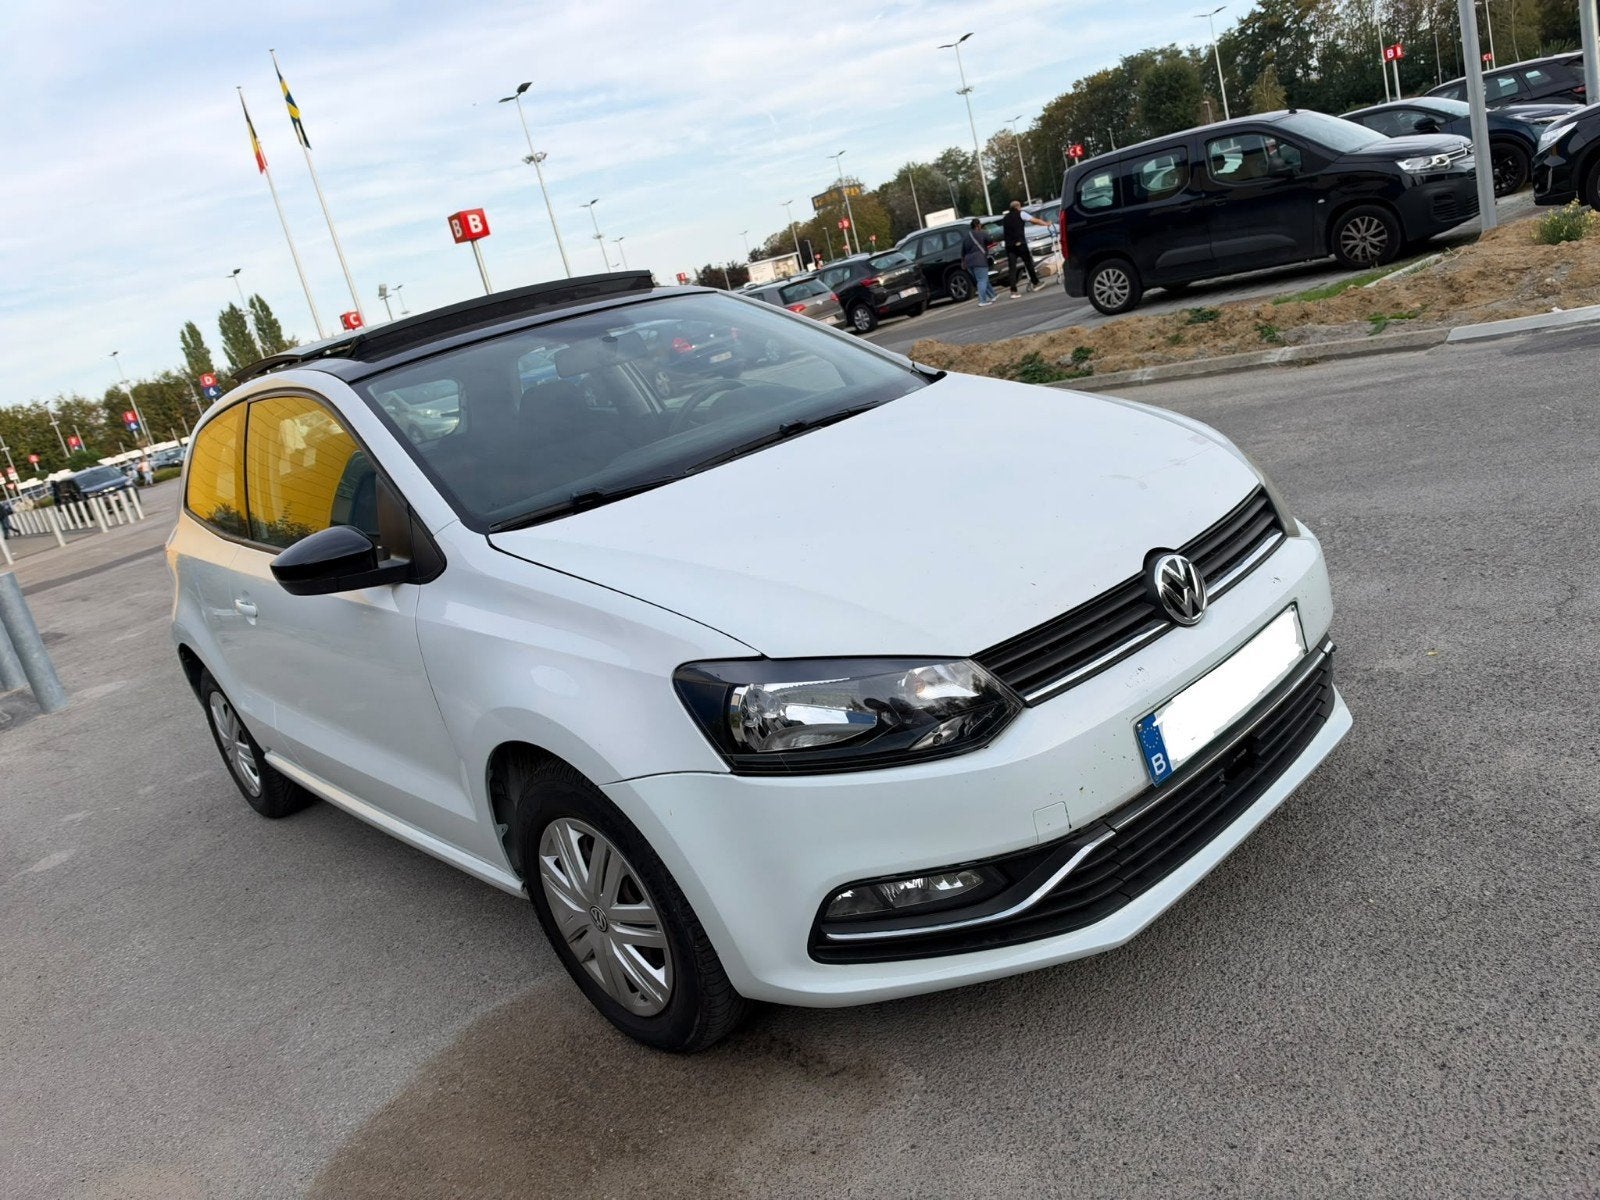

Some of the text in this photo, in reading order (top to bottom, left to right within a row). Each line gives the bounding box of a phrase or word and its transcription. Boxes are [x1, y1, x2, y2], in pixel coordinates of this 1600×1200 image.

[1386, 48, 1395, 60] B
[1069, 147, 1076, 157] C
[451, 218, 463, 238] B
[467, 214, 483, 234] B
[349, 313, 359, 326] C
[204, 374, 212, 385] D
[1151, 752, 1167, 776] B
